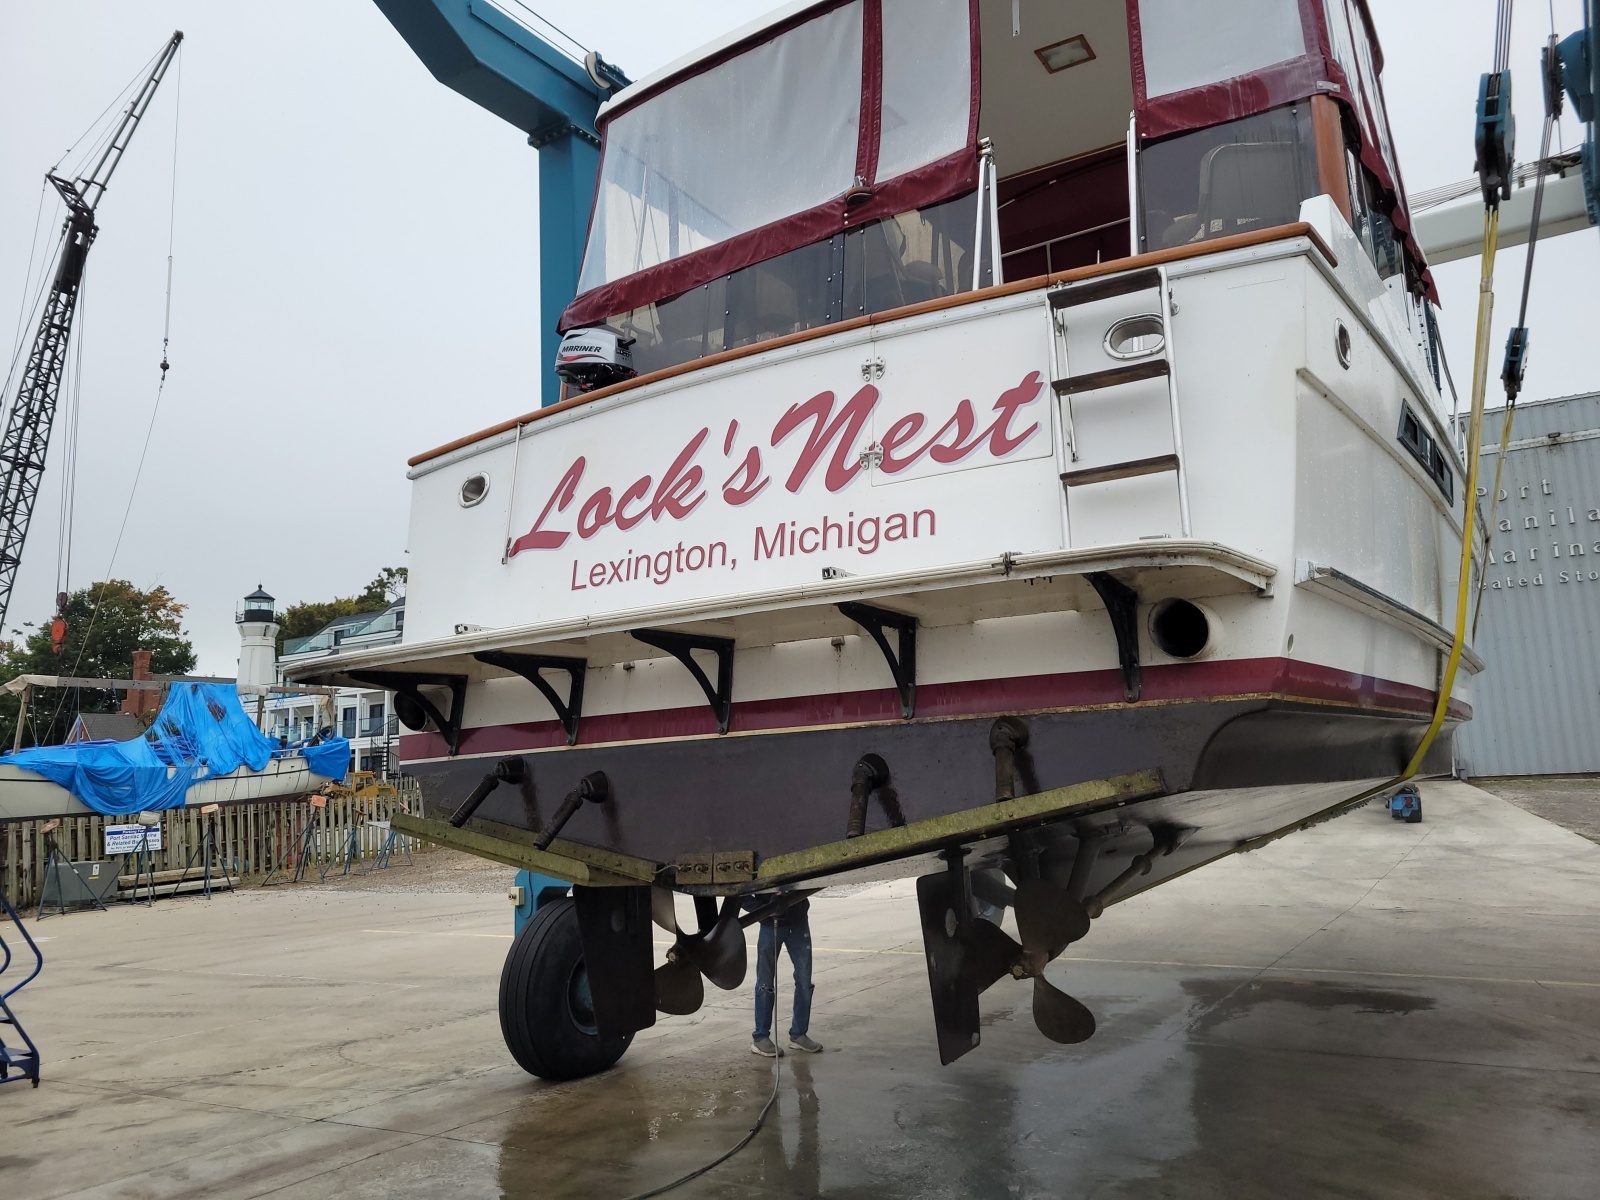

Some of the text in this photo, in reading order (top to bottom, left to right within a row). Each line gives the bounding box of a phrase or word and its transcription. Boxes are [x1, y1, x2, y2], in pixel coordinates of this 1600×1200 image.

[561, 345, 602, 353] MARINER
[508, 370, 1045, 558] Lock's Nest
[1499, 507, 1600, 532] anila
[571, 509, 936, 591] Lexington, Michigan
[1477, 573, 1544, 590] eated
